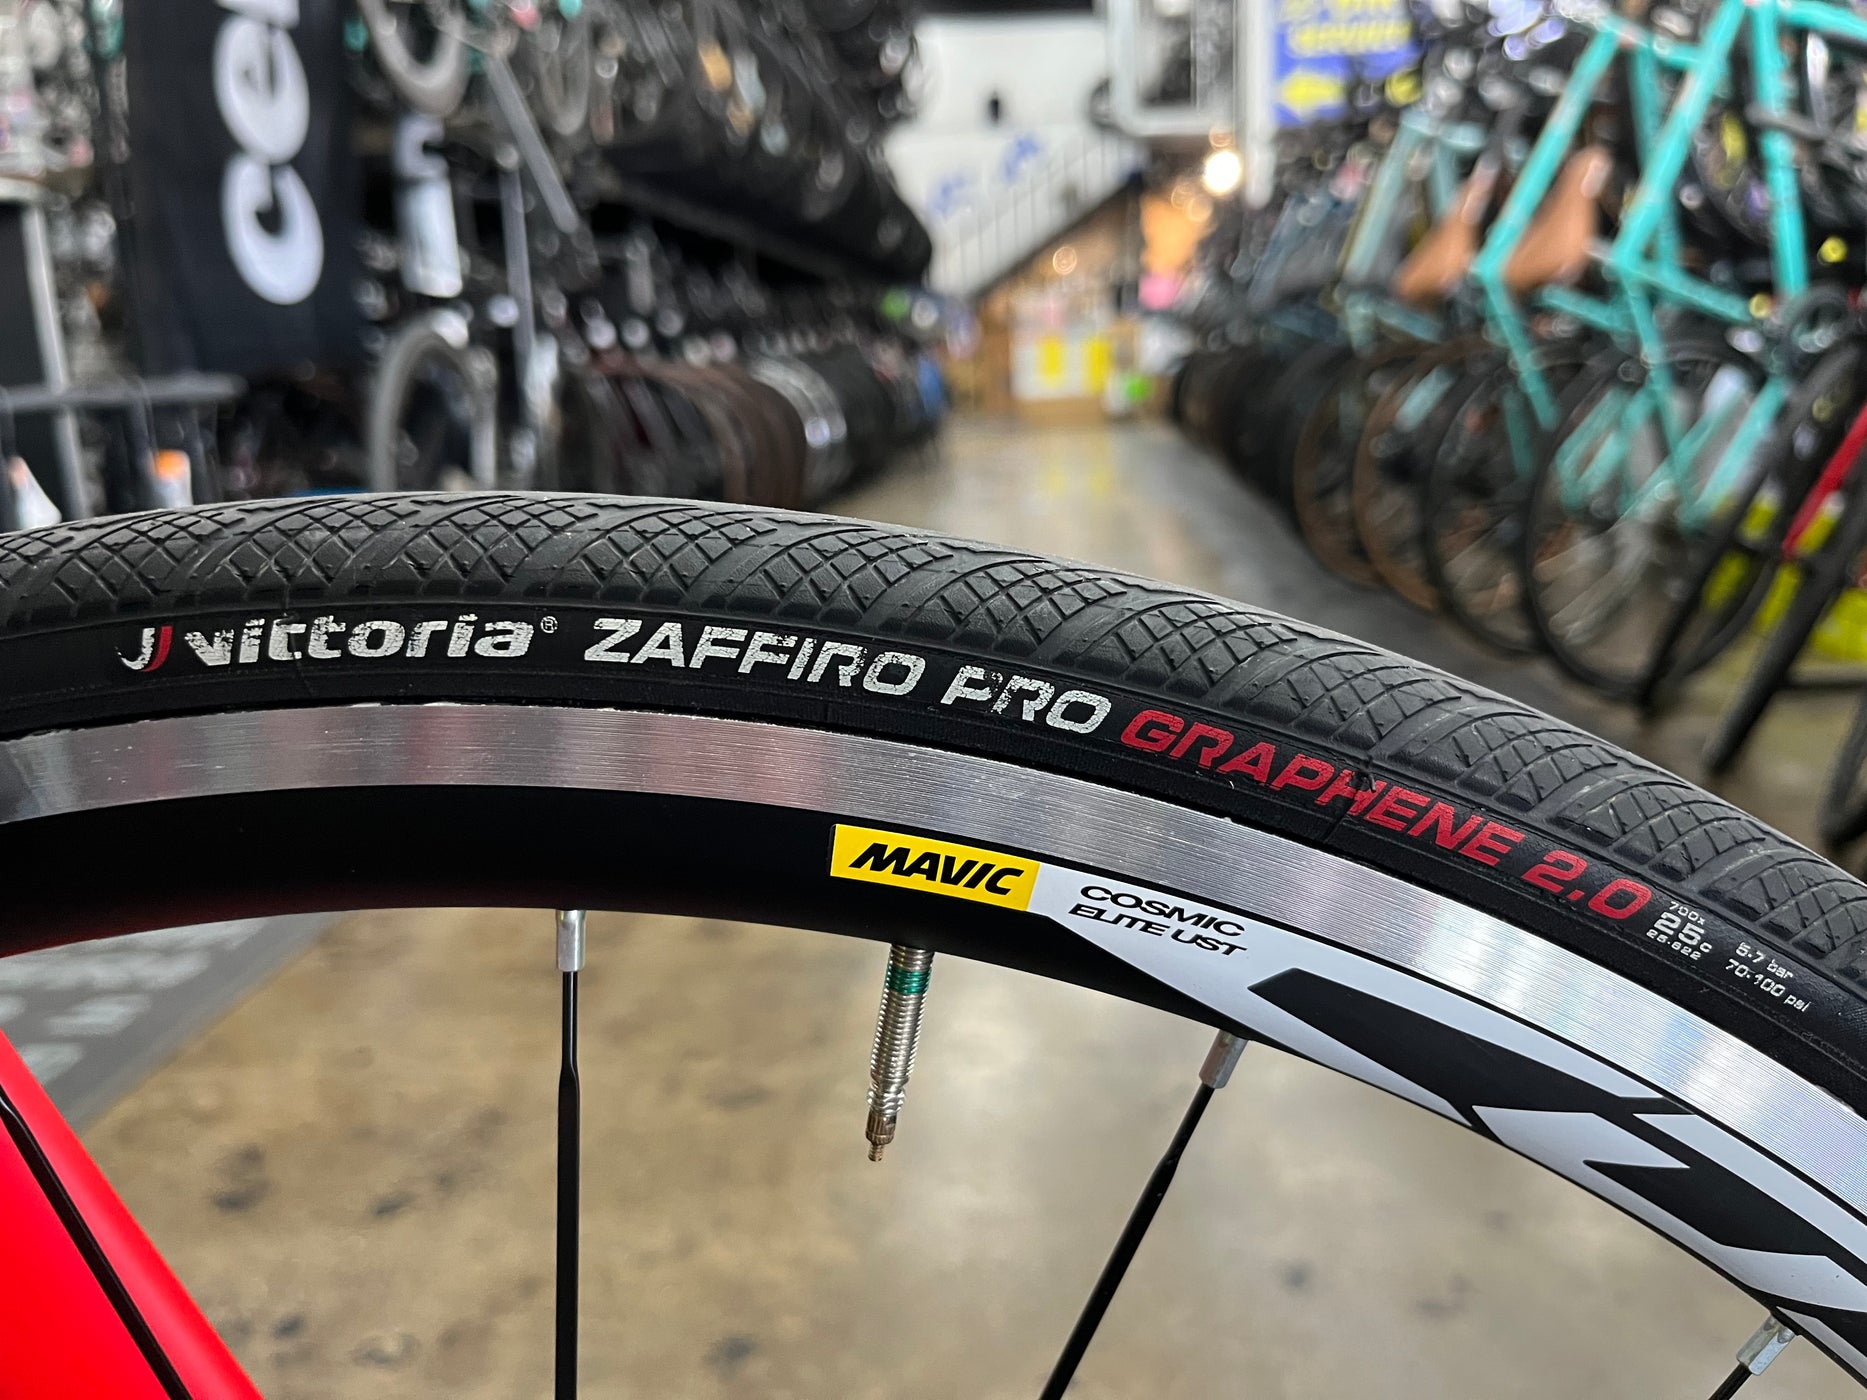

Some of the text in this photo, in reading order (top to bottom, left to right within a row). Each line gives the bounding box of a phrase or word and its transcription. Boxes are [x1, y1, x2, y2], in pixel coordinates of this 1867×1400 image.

[583, 617, 926, 697] ZAFFIRO
[940, 664, 1112, 735] PRO
[1120, 708, 1525, 867] GRAPHENE
[1522, 849, 1653, 920] 2.0
[849, 842, 1025, 896] MAVIC
[1068, 903, 1248, 957] ELITE UST
[1080, 885, 1246, 938] COSMIC
[1766, 958, 1794, 979] bar
[1783, 994, 1812, 1012] psi
